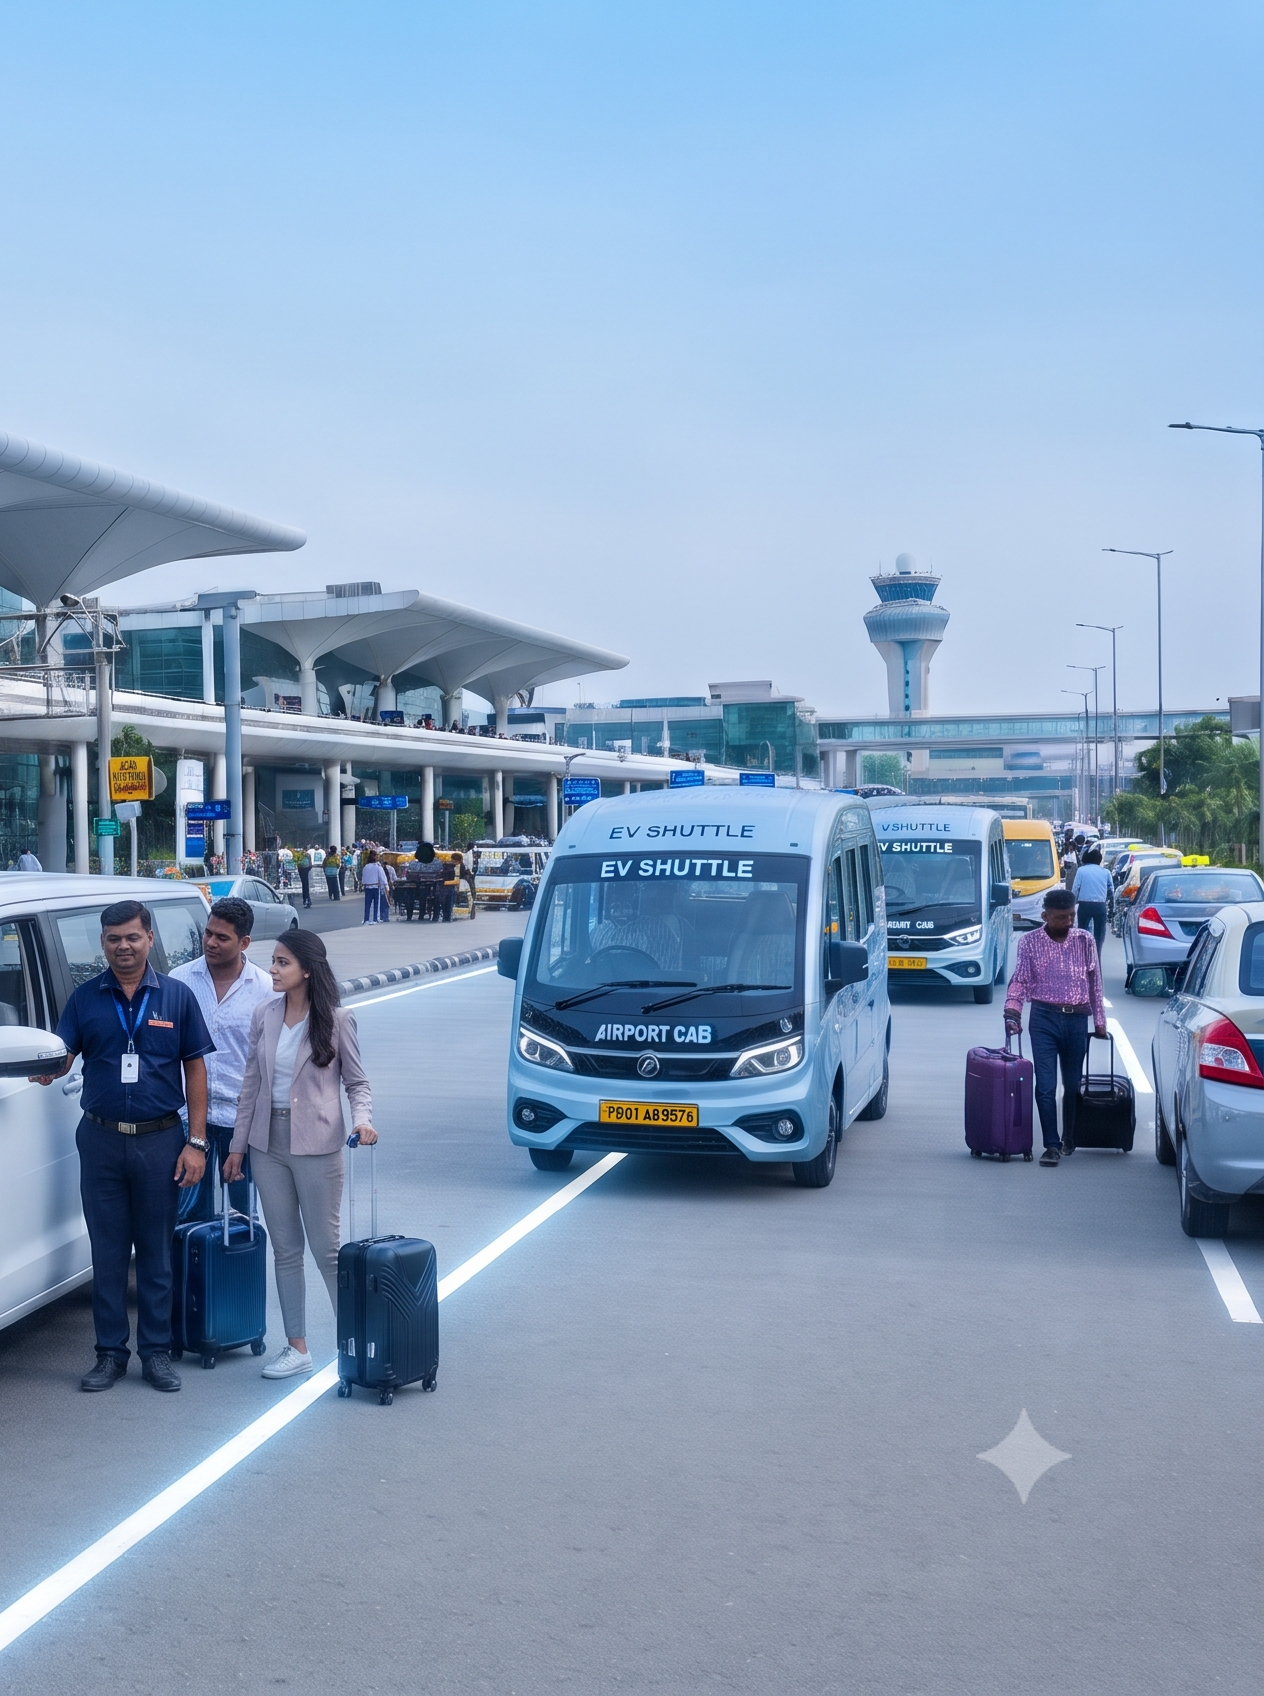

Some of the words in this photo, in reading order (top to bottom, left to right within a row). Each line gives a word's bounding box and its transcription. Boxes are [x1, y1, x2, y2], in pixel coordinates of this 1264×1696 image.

[609, 826, 641, 839] EV
[646, 824, 755, 838] SHUTTLE
[892, 842, 953, 853] SHUTTLE
[601, 859, 633, 878] EV
[638, 858, 754, 878] SHUTTLE
[595, 1023, 670, 1042] AIRPORT
[673, 1025, 712, 1044] CAB
